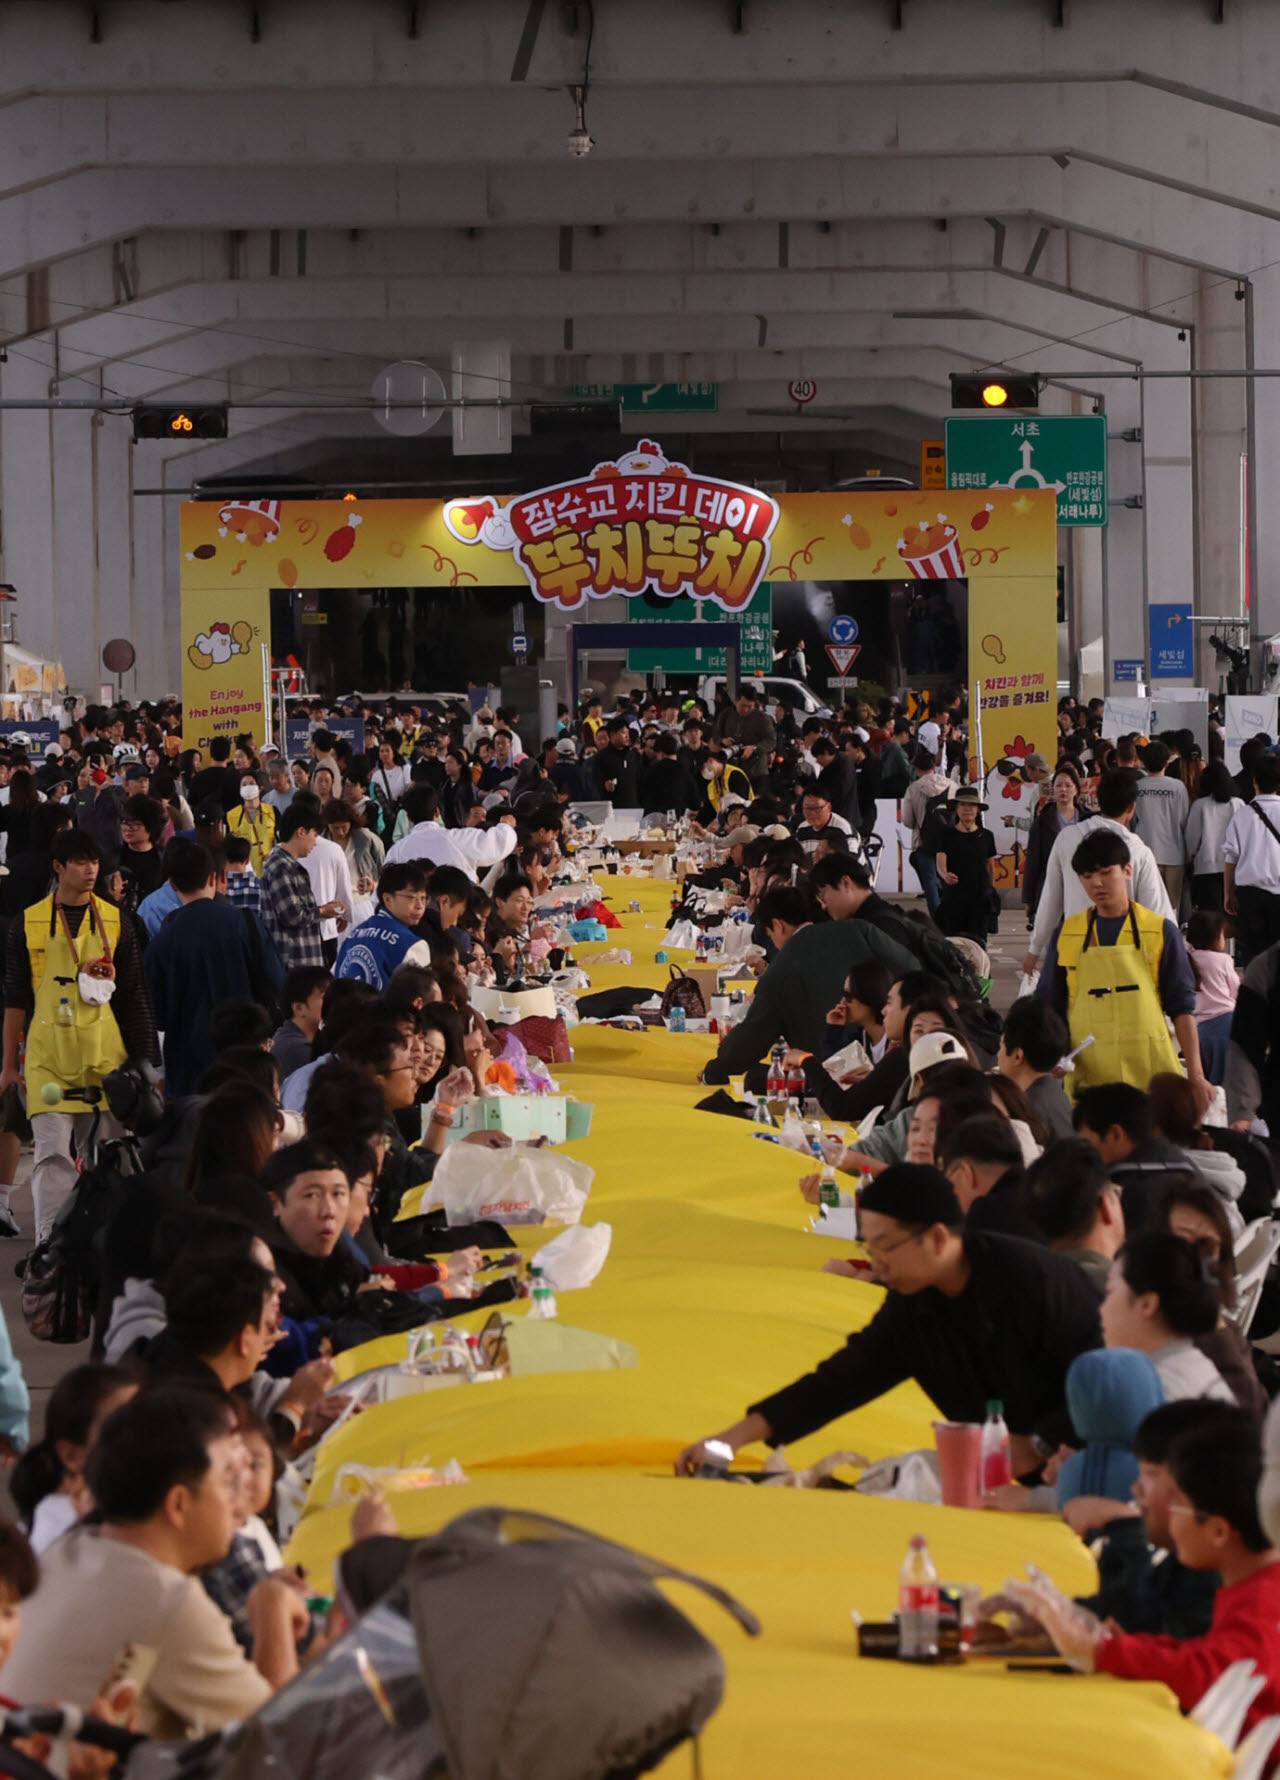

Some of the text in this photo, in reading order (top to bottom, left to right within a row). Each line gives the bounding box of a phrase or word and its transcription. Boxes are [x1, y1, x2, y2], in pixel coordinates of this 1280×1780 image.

[795, 382, 810, 397] 40
[1011, 422, 1041, 437] 서초
[951, 472, 987, 487] 올림픽대로
[1066, 471, 1104, 486] 반포한강공원
[1068, 487, 1102, 501] (세빛섬)
[521, 481, 760, 538] 잠수교 치킨 데이
[984, 672, 1044, 690] 치킨과 함께
[210, 688, 244, 700] Enjoy
[1013, 690, 1049, 706] 즐겨요!
[189, 702, 262, 719] the Hangang
[213, 719, 239, 731] with
[381, 929, 399, 945] US
